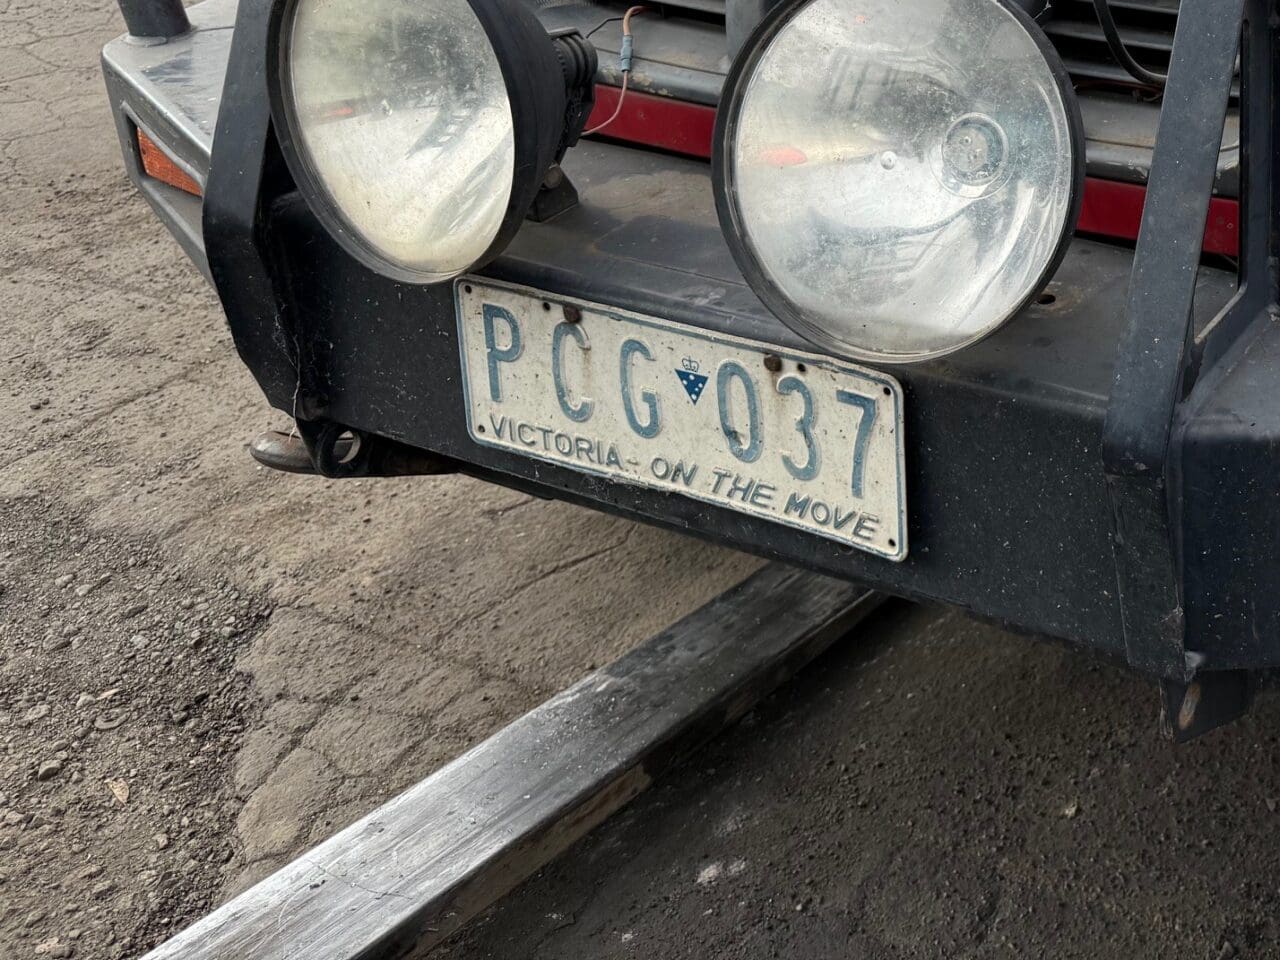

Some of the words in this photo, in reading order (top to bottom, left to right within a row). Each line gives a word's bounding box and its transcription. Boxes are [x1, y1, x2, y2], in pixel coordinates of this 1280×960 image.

[482, 303, 663, 439] PCG
[716, 360, 879, 499] 037
[652, 456, 698, 488] ON
[711, 467, 777, 509] THE
[784, 492, 880, 541] MOVE
